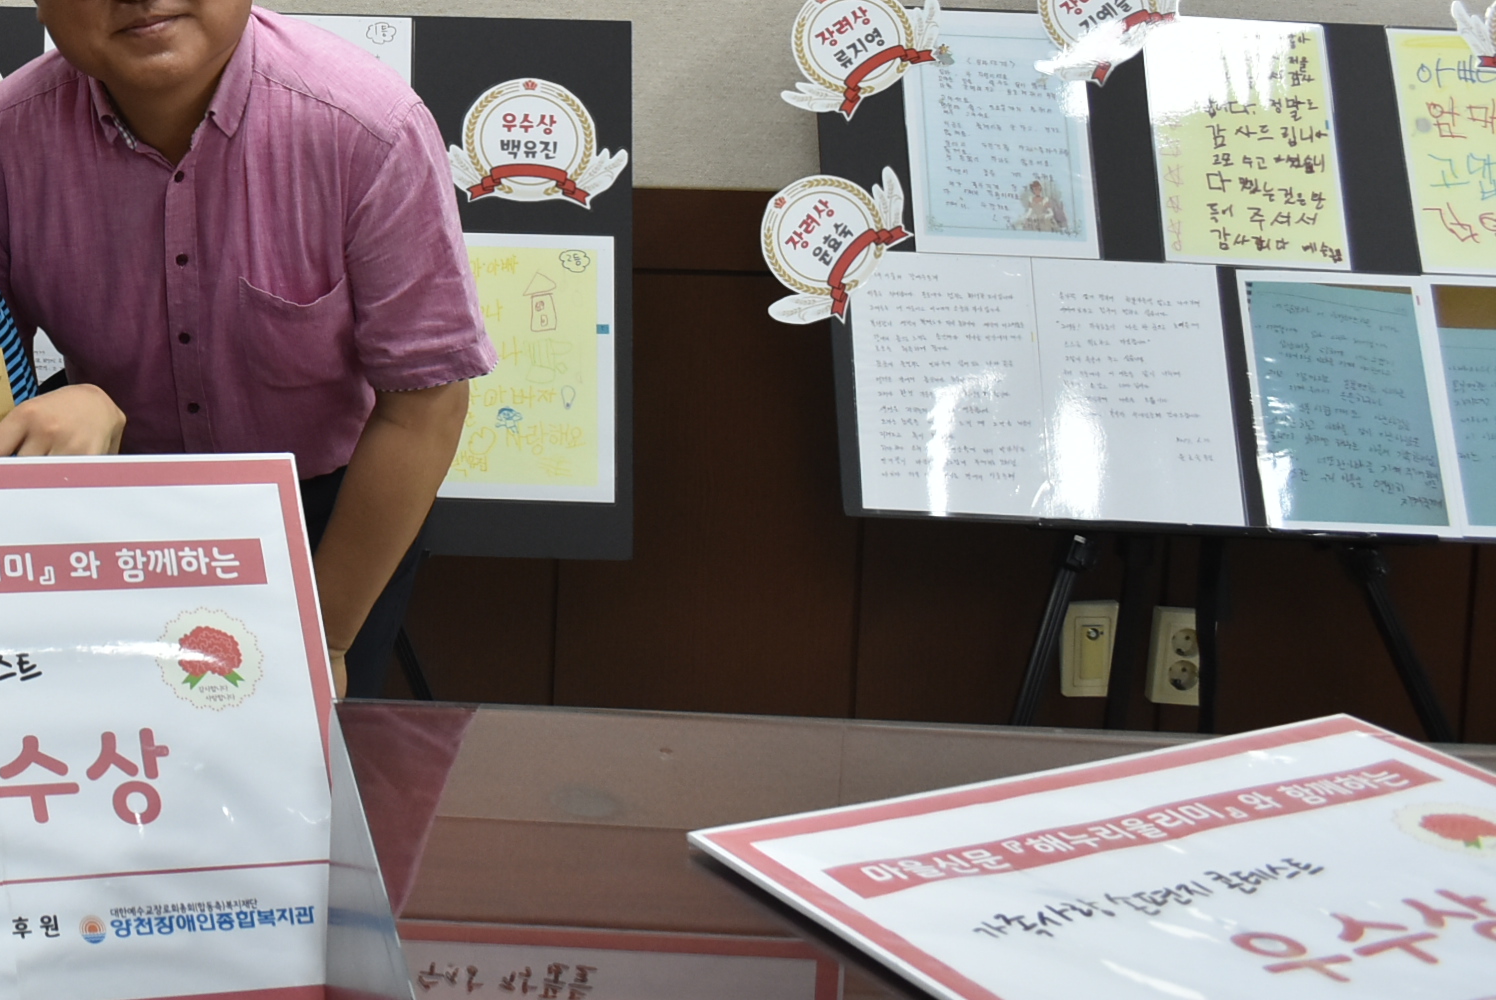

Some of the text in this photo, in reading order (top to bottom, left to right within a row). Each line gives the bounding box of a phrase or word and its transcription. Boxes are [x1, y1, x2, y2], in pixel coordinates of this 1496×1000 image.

[815, 6, 871, 47] 장려상
[833, 27, 885, 69] 류지영
[502, 113, 557, 135] 우수상
[500, 139, 558, 160] 백유진
[785, 199, 835, 250] 장려상
[69, 551, 100, 579] 와
[115, 547, 240, 583] 함께하는
[860, 849, 1013, 882] 마을신문
[1237, 791, 1282, 811] 와
[1276, 770, 1410, 806] 함께하는
[973, 858, 1324, 939] 가족사랑 손편지 콘테스트
[110, 905, 315, 939] 양천장애인종합복지관
[1230, 889, 1496, 983] 우수상
